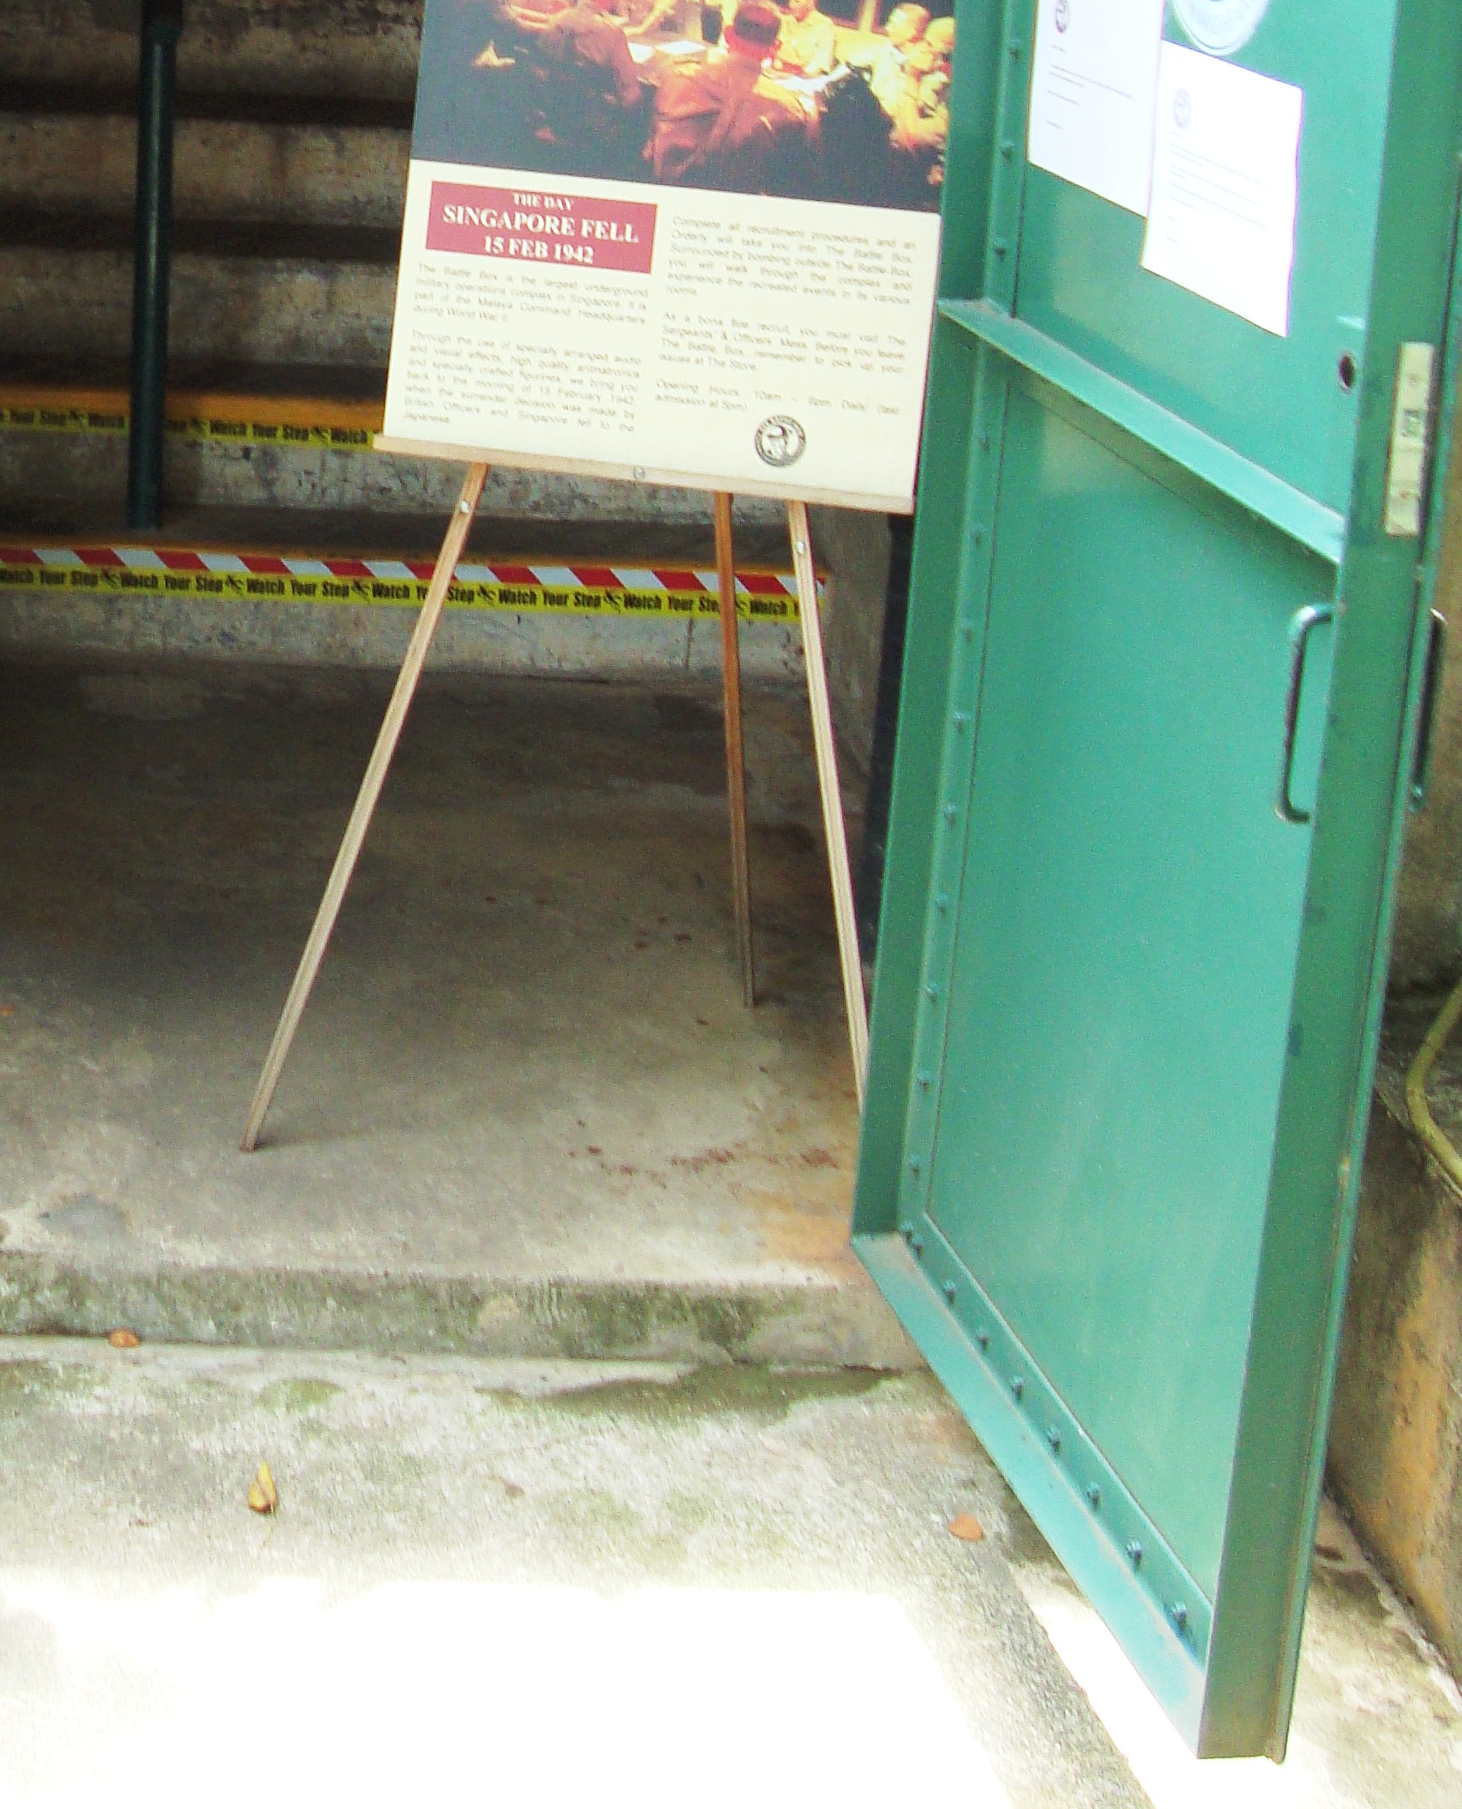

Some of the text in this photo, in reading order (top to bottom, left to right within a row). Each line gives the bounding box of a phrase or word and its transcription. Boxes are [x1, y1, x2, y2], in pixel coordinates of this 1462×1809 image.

[512, 192, 574, 211] THE DAY
[443, 204, 638, 243] SINGAPORE FELL
[484, 236, 594, 264] 15 FEB 1942
[10, 408, 36, 425] Your
[40, 410, 67, 427] Step
[88, 413, 125, 428] Watch
[209, 420, 247, 437] Watch
[252, 422, 278, 439] Your
[283, 423, 309, 442] Step
[331, 426, 368, 444] Watch
[40, 571, 66, 586] Your
[71, 570, 98, 588] Step
[121, 572, 158, 589] Watch
[164, 574, 189, 590] Your
[195, 576, 223, 593] Step
[247, 578, 285, 595] Watch
[290, 579, 317, 597] Your
[322, 581, 350, 599] Step
[372, 582, 410, 600] Watch
[498, 589, 537, 606] Watch
[542, 590, 569, 608] Your
[573, 593, 602, 610] Step
[624, 593, 662, 610] Watch
[667, 596, 694, 613] Your
[698, 597, 720, 614] Ste
[749, 600, 789, 617] Watch
